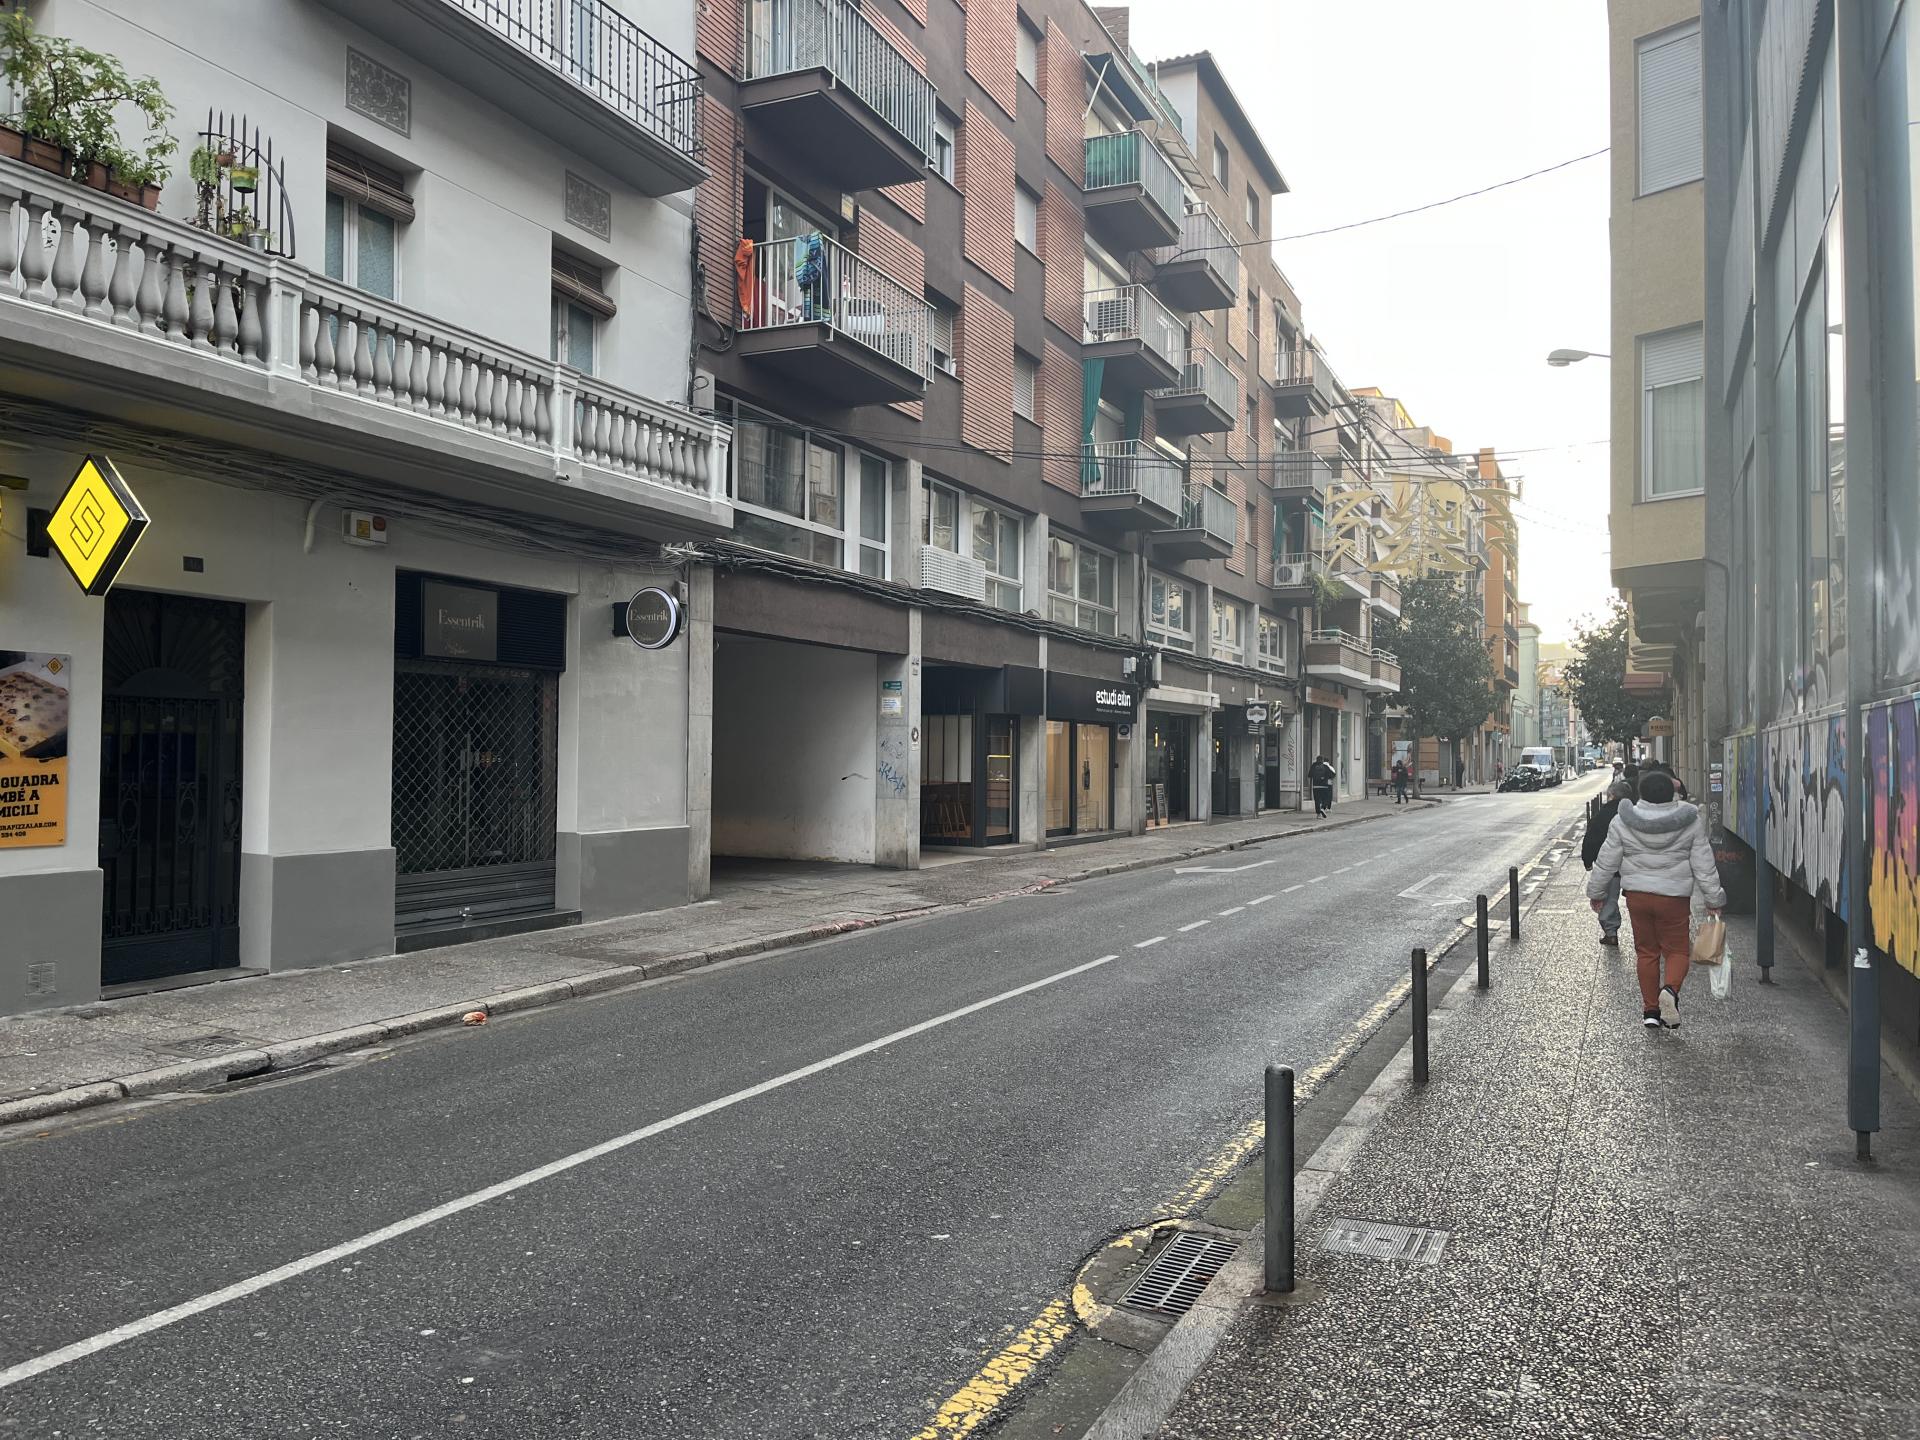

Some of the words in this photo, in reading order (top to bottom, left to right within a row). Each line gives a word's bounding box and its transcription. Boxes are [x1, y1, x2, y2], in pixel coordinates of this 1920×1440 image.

[438, 608, 485, 629] Essentrik
[630, 609, 668, 621] Essentrik
[1095, 689, 1117, 706] estudi
[29, 789, 40, 801] A
